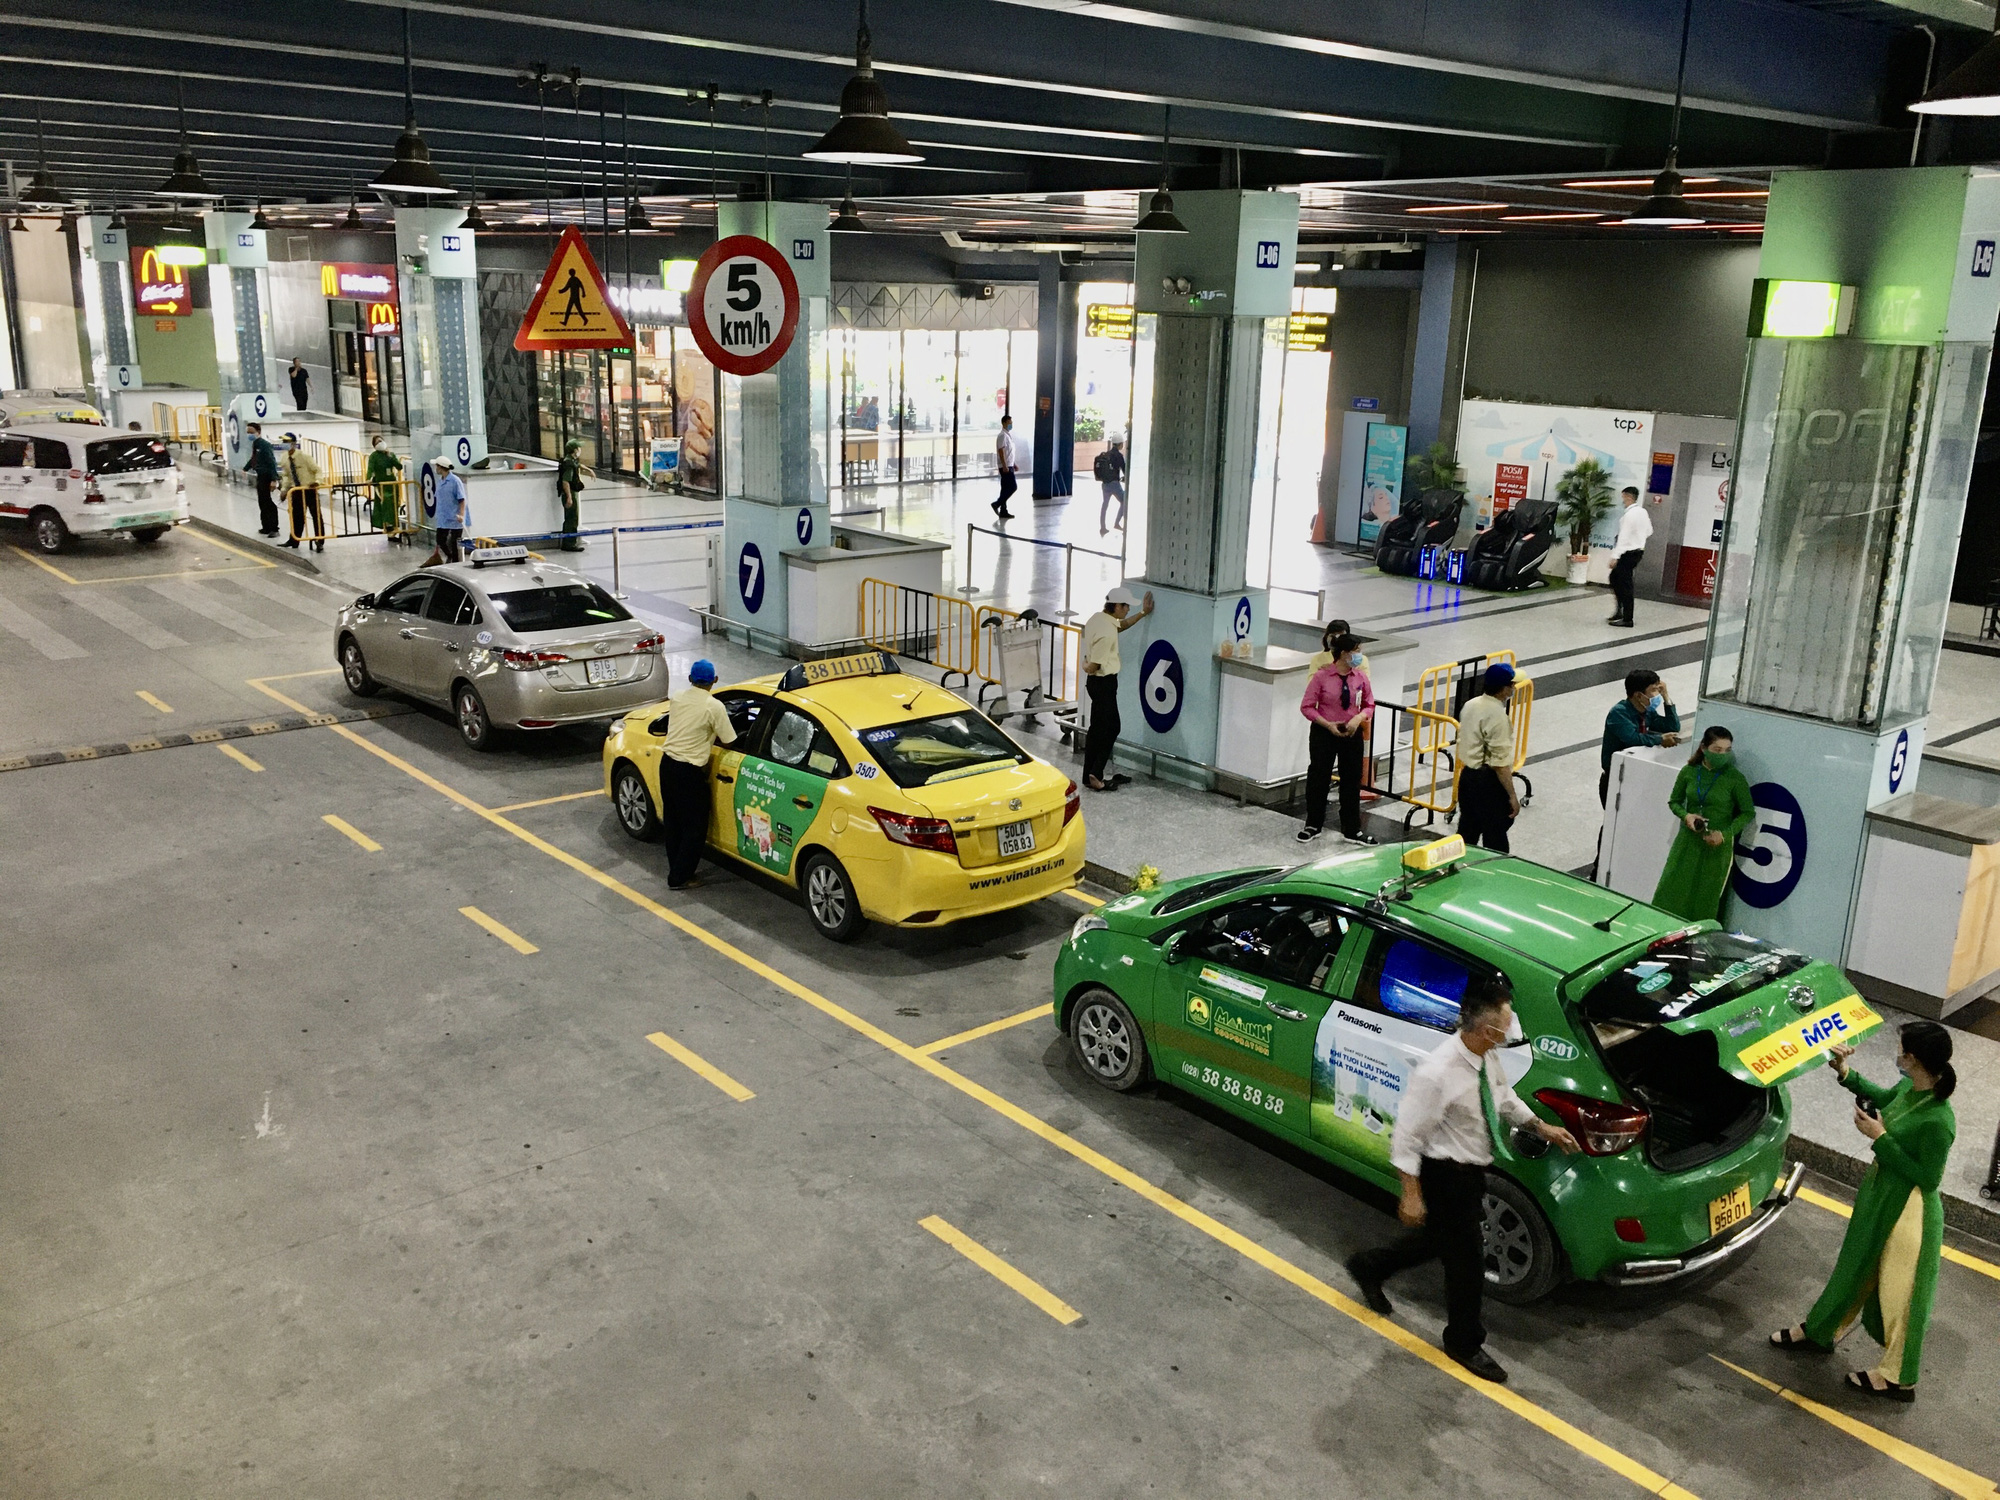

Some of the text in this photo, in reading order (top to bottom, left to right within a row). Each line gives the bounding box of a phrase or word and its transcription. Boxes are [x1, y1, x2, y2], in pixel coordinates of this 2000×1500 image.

[794, 242, 812, 258] D-07
[1258, 245, 1279, 265] D-06
[1973, 245, 1994, 273] D-05
[726, 263, 762, 312] 5
[720, 312, 771, 349] km/h
[256, 397, 266, 415] 9
[1614, 417, 1637, 433] tcp
[459, 441, 469, 461] 8
[1502, 466, 1524, 475] POSH
[423, 474, 436, 508] 8
[799, 515, 810, 539] 7
[743, 554, 760, 599] 7
[1236, 606, 1249, 636] 6
[593, 658, 611, 670] 51G
[808, 656, 879, 680] 38 111 111
[1144, 658, 1178, 715] 6
[870, 729, 896, 742] 3503
[855, 762, 877, 779] 3503
[1890, 741, 1907, 782] 5
[1002, 836, 1033, 854] 058.83
[1734, 805, 1793, 884] 5
[968, 857, 1066, 891] www.vinataxi.vn
[1337, 1009, 1383, 1035] Panasonic
[1213, 1026, 1270, 1057] CORPORATION
[1539, 1037, 1574, 1059] 6201
[1751, 1053, 1779, 1075] ĐÈN
[1801, 1011, 1848, 1047] MPE
[1181, 1061, 1285, 1115] (028) 38 38 38 38
[1714, 1200, 1747, 1232] 958.01
